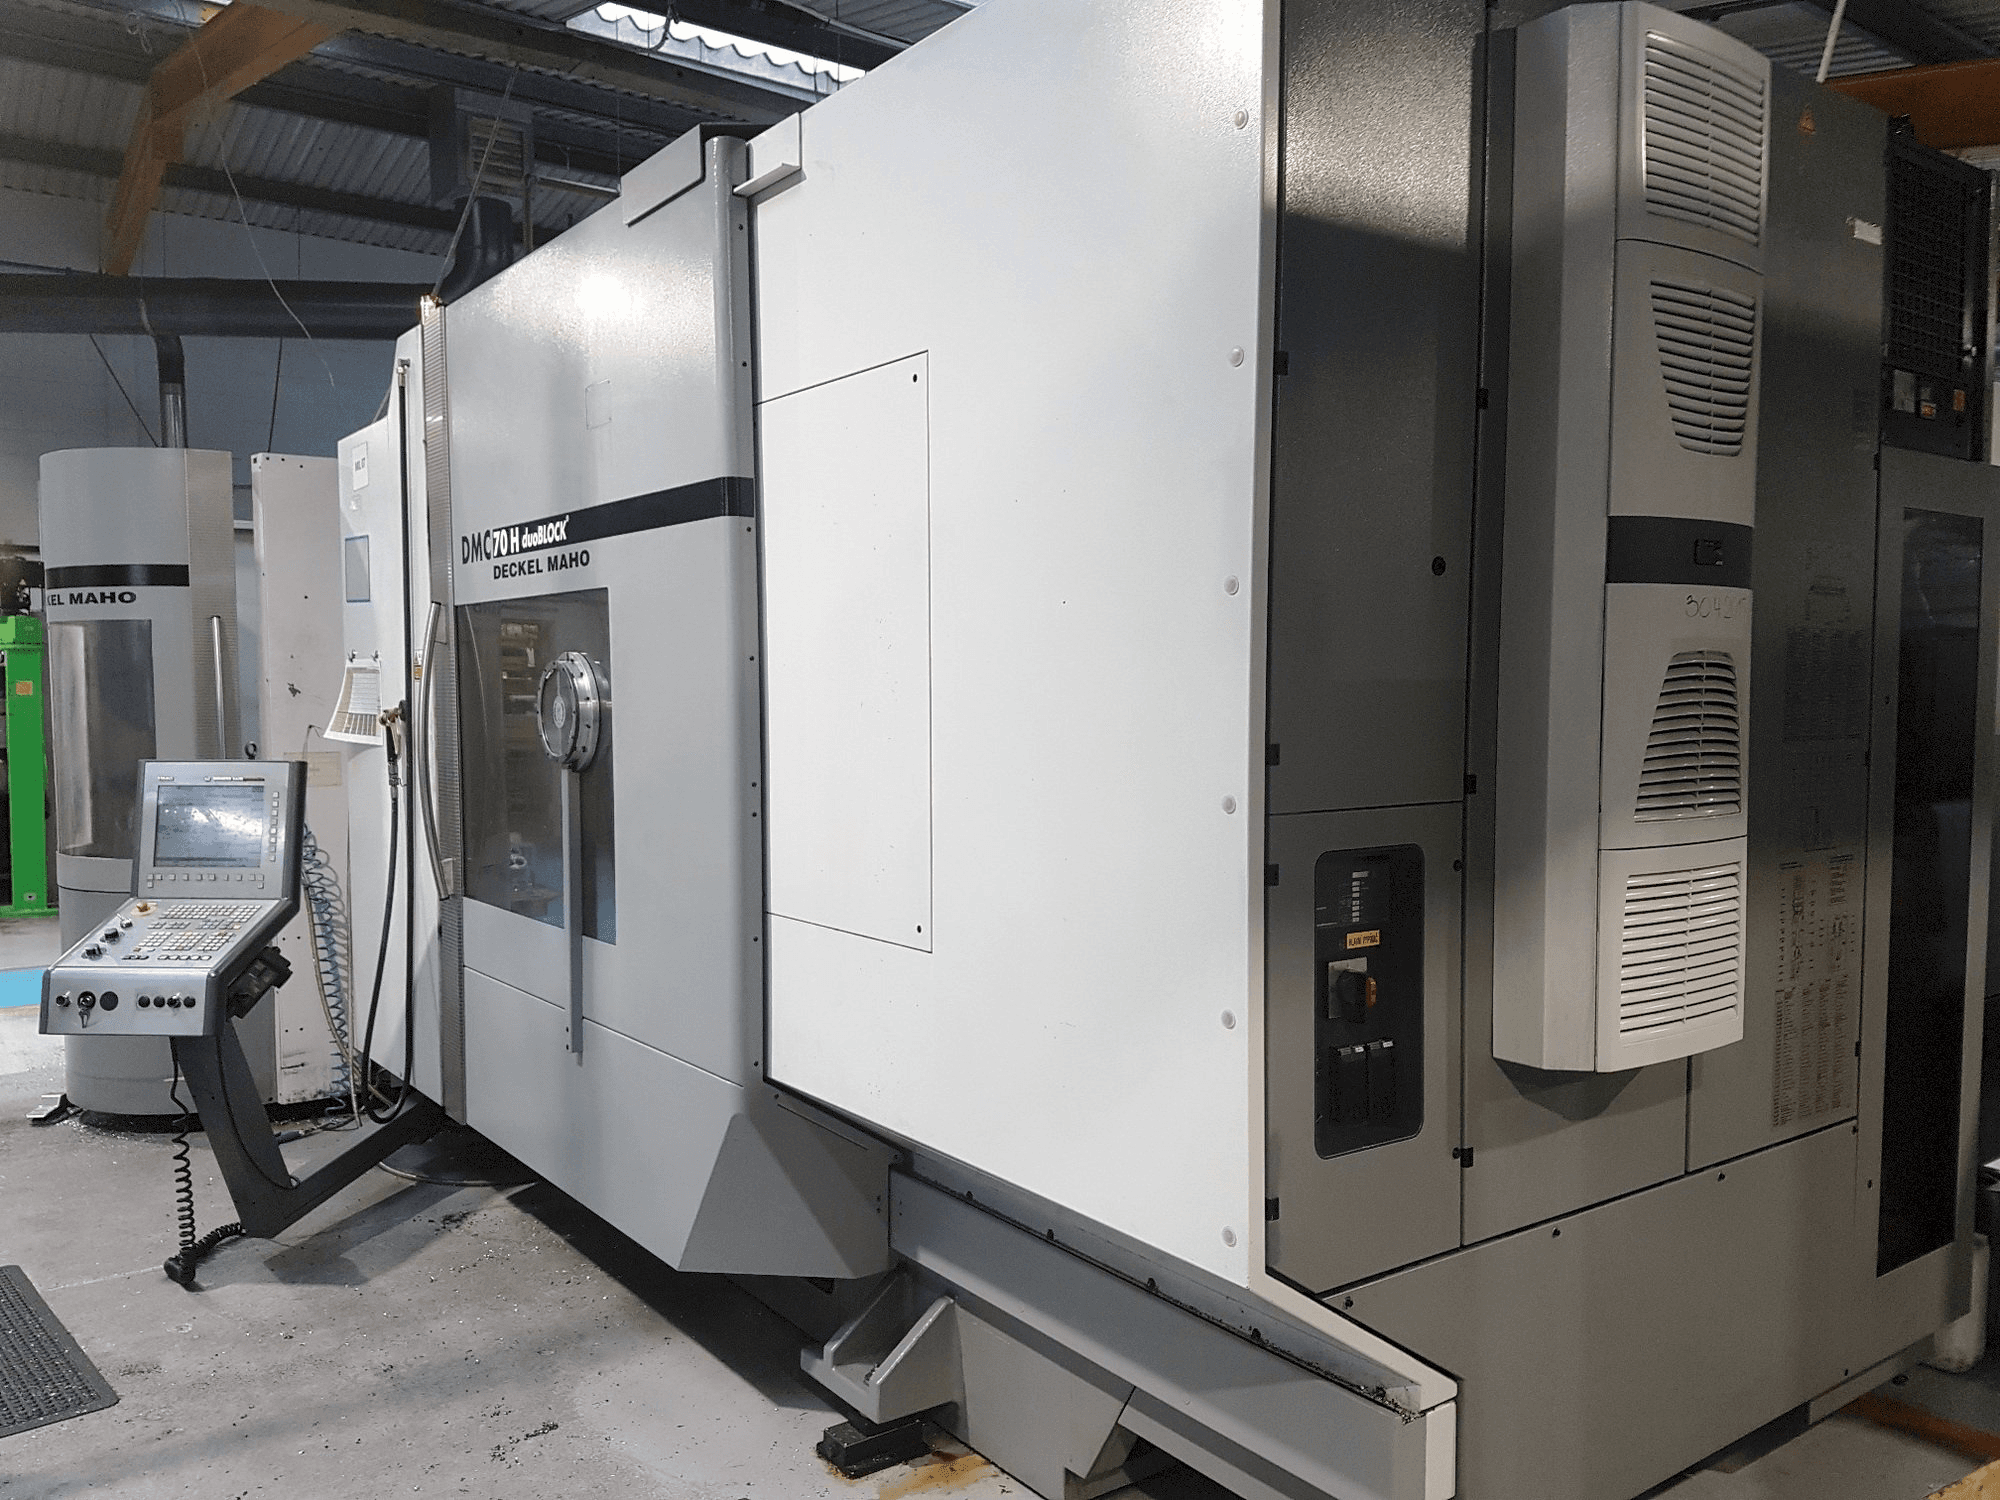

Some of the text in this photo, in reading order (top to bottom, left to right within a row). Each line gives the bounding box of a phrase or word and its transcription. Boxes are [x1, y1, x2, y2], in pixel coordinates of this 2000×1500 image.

[493, 549, 590, 580] DECKEL MAHO
[69, 591, 137, 605] MAHO
